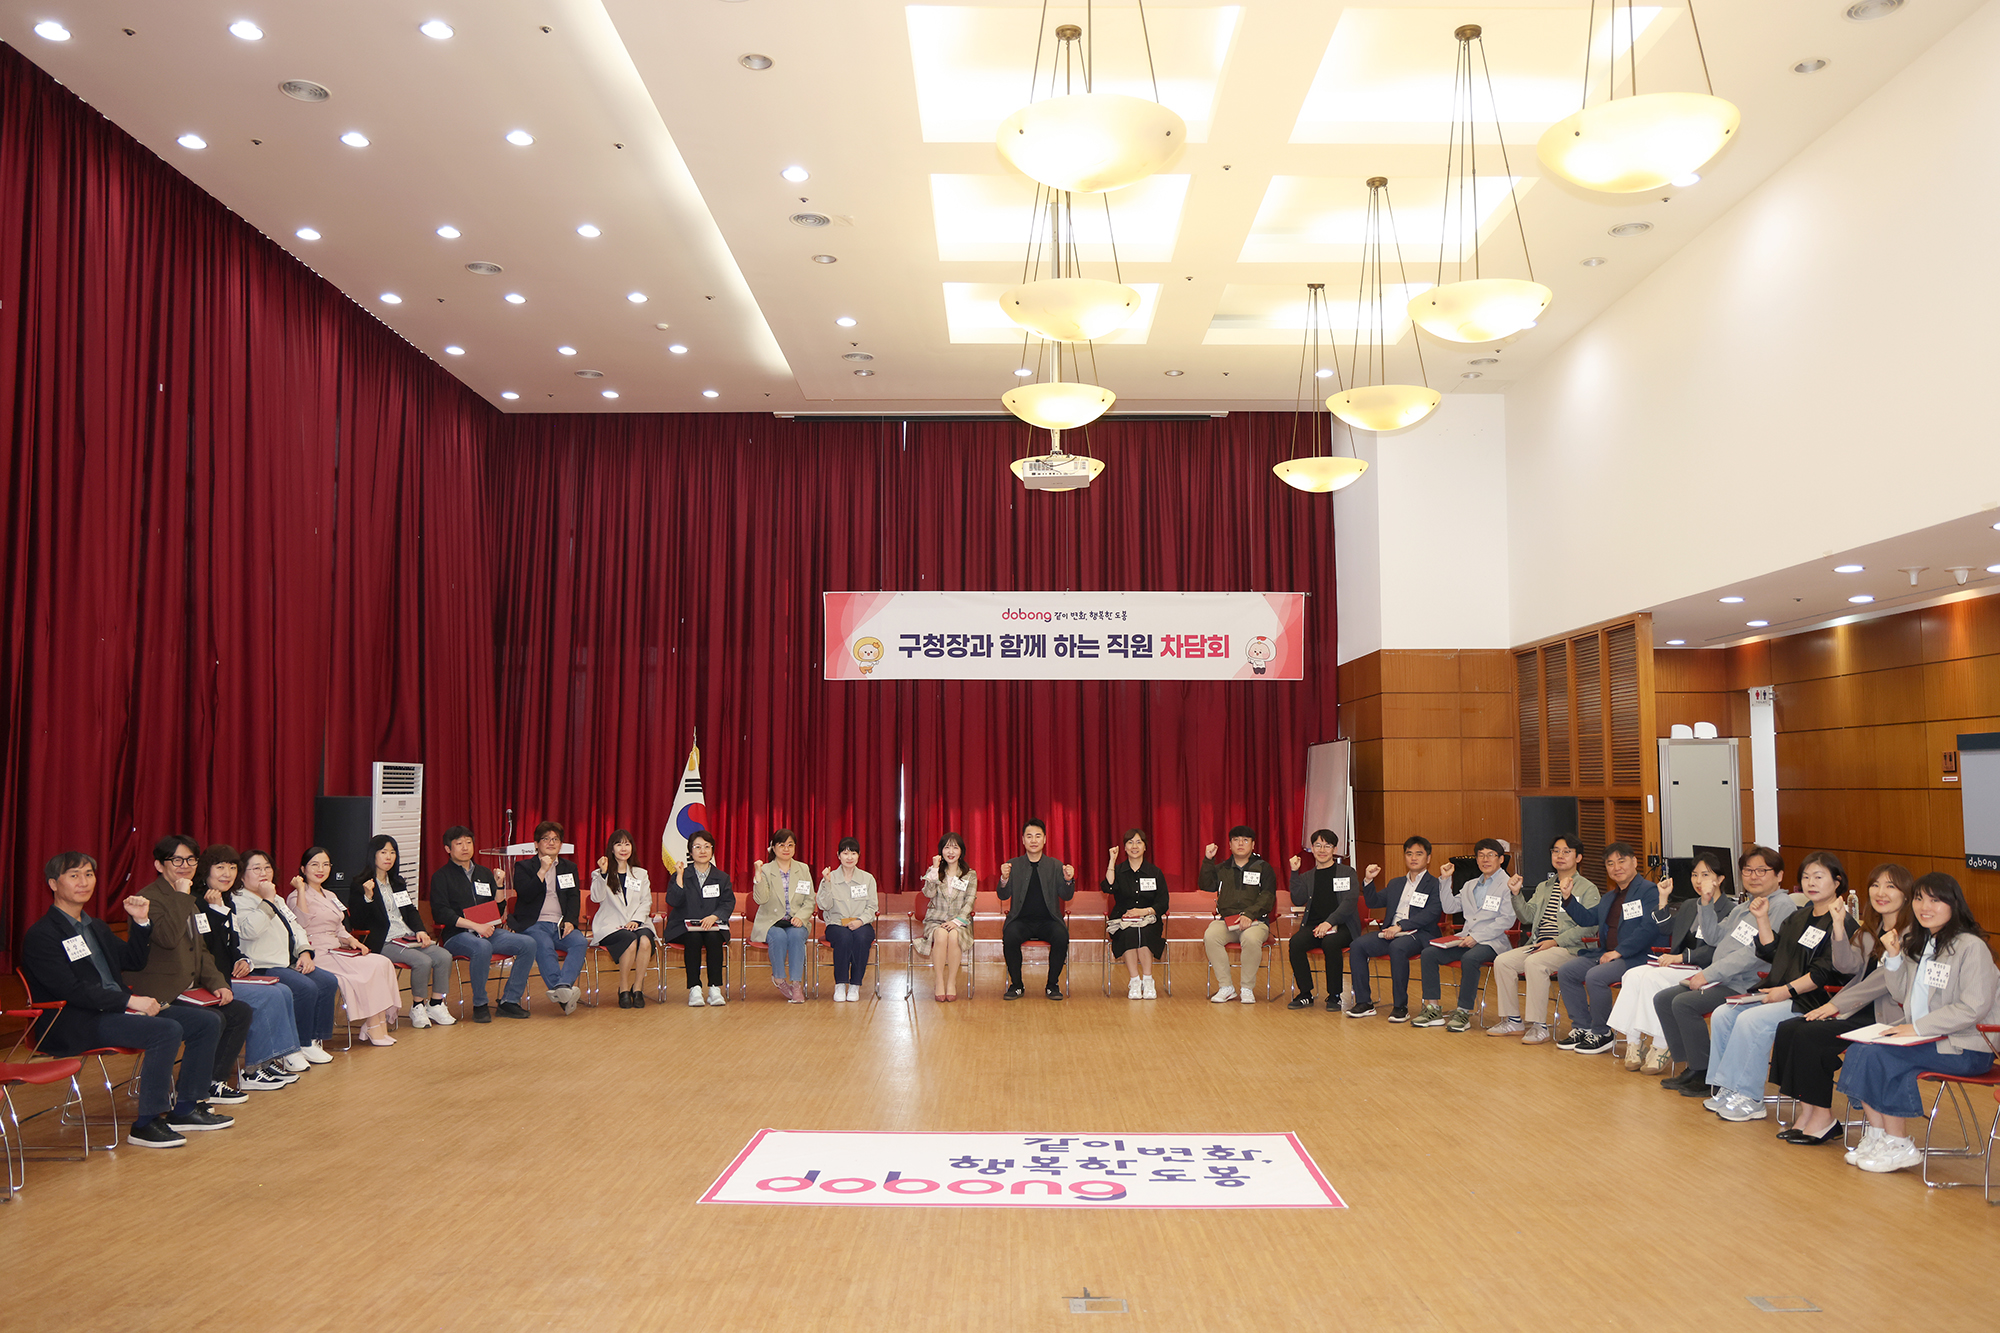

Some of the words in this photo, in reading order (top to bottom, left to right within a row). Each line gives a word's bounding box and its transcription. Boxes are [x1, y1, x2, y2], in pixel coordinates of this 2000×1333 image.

[1001, 607, 1052, 623] dobong
[1054, 611, 1069, 621] 같이
[1089, 610, 1113, 621] 행복한
[1115, 611, 1128, 622] 도봉
[898, 633, 994, 659] 구청장과
[999, 633, 1047, 659] 함께
[1053, 633, 1100, 659] 하는
[1107, 633, 1153, 659] 직원
[1160, 634, 1230, 659] 차담회
[1968, 857, 1998, 870] dobong
[1023, 1137, 1126, 1153] 같이
[948, 1155, 1138, 1176] 행복한
[1148, 1165, 1251, 1188] 도봉
[755, 1169, 1128, 1202] dobong
